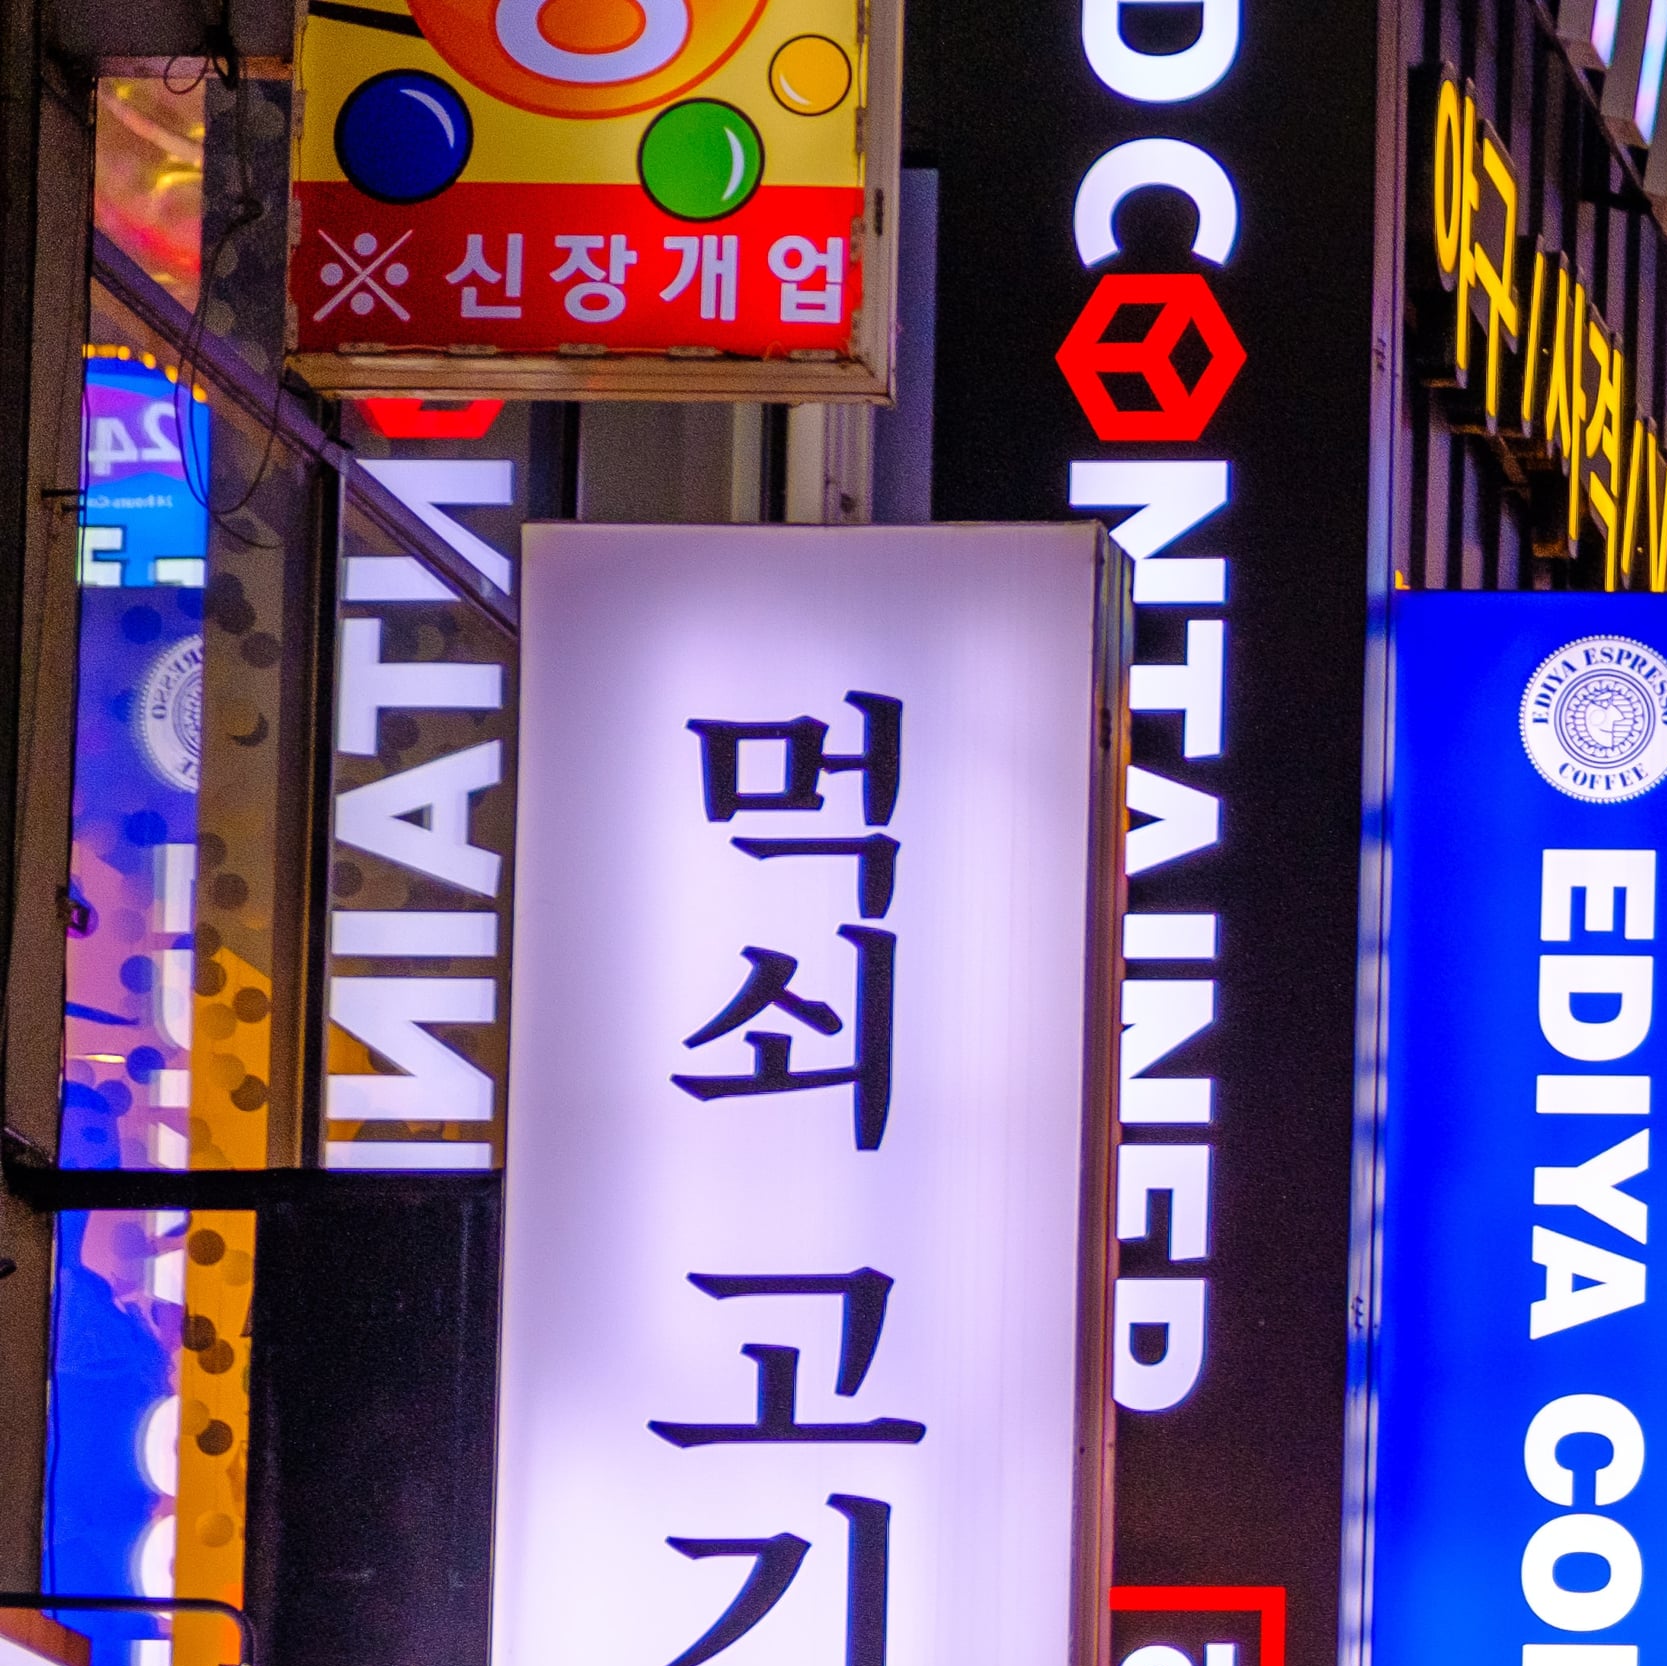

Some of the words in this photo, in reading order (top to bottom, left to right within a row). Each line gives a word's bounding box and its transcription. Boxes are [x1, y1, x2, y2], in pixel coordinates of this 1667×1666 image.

[446, 233, 844, 324] 신장개업
[1531, 655, 1581, 728] EDIYA
[1557, 762, 1651, 792] COFFEE
[1529, 848, 1658, 1341] EDIYA
